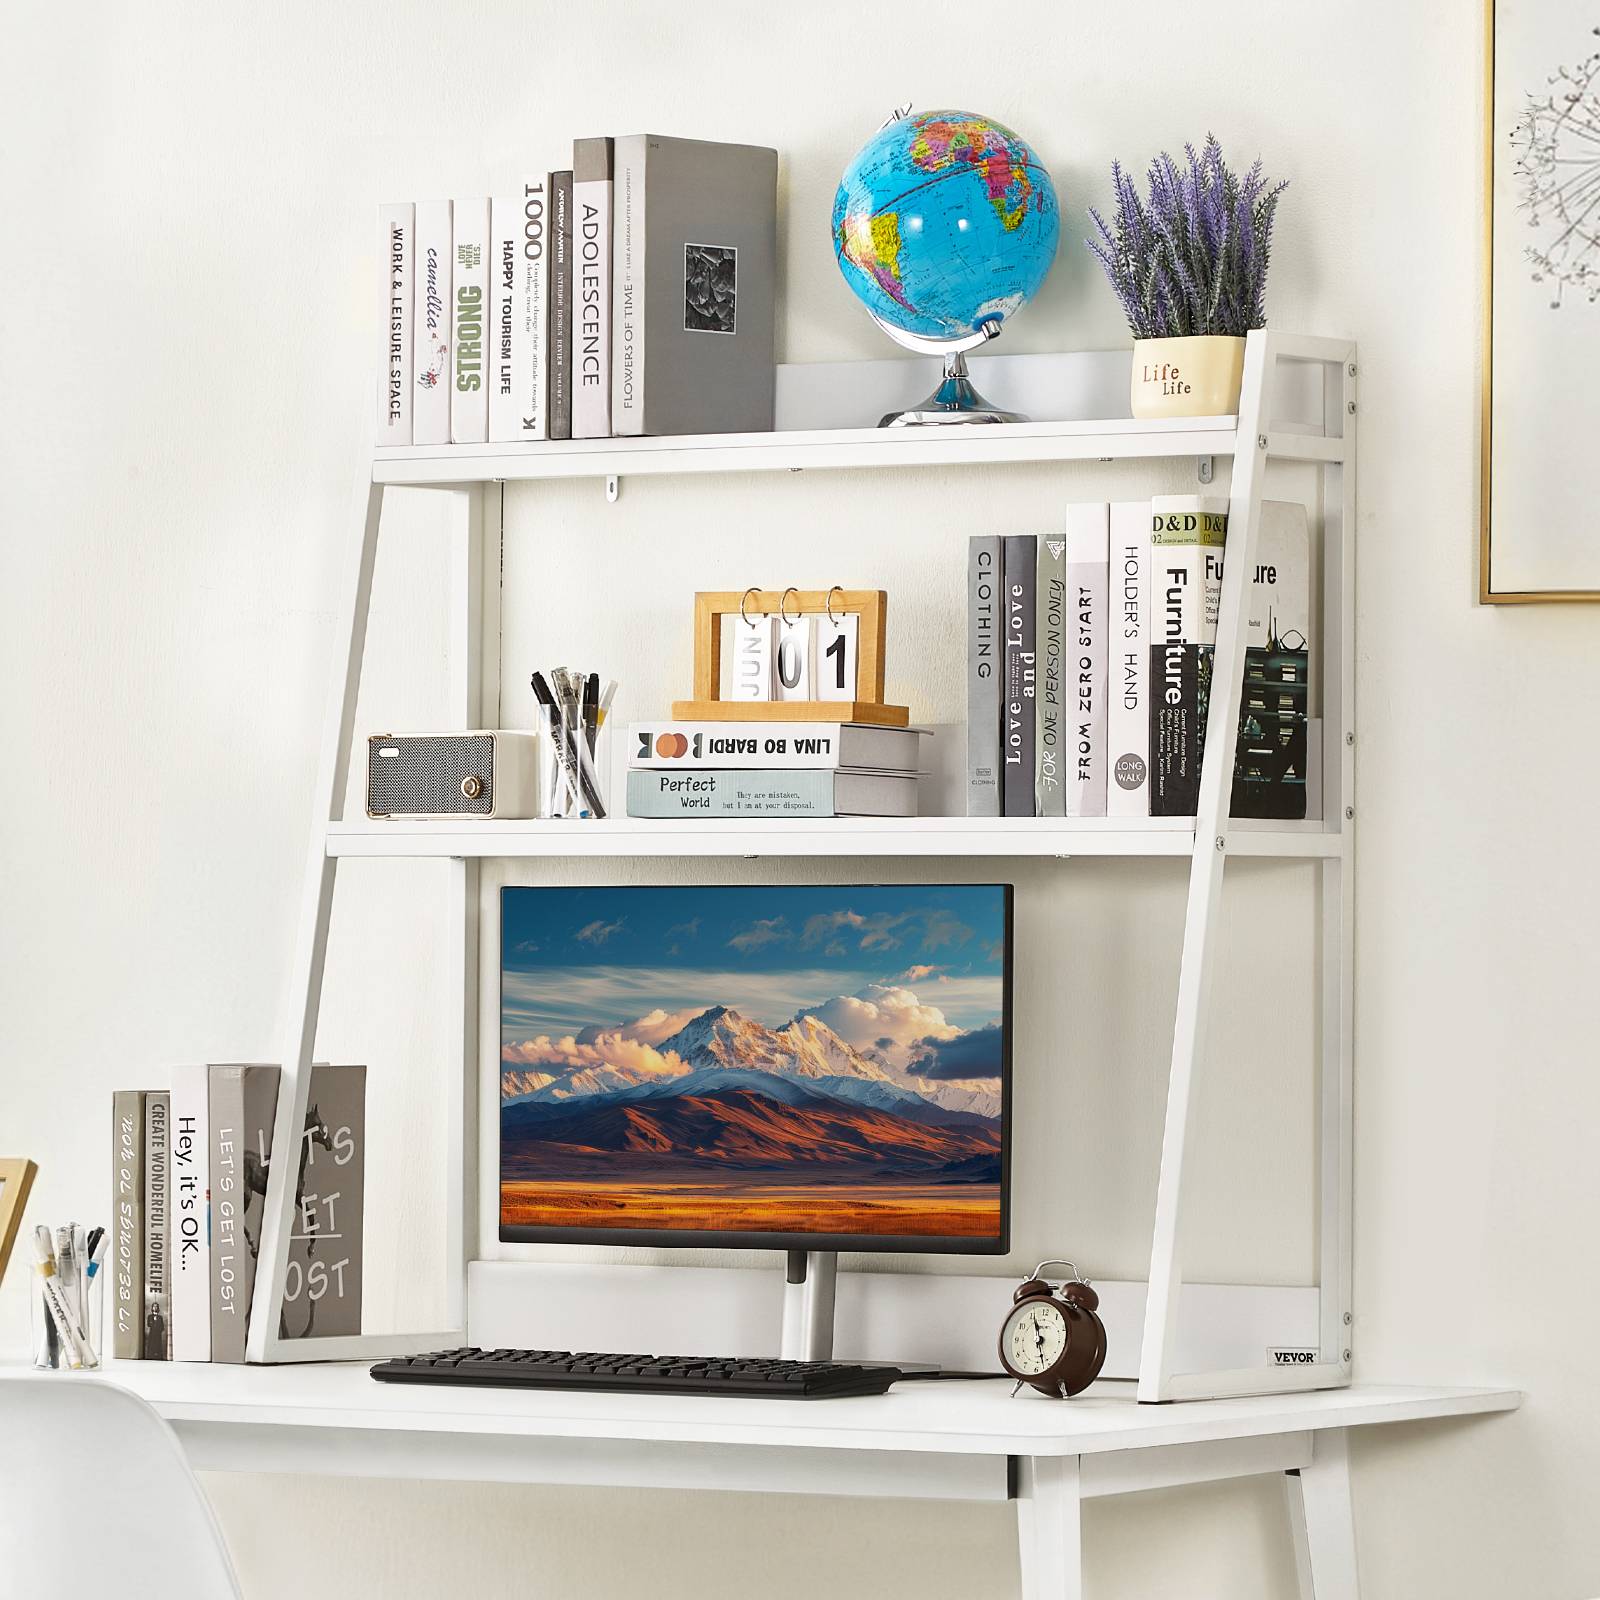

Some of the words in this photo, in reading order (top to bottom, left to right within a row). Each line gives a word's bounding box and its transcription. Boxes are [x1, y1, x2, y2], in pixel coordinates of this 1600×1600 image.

[524, 182, 544, 260] 1000
[392, 228, 404, 274] WORK
[458, 244, 466, 264] LOVE
[502, 240, 514, 290] HAPPY
[392, 280, 402, 290] &
[426, 248, 443, 331] camellia
[582, 204, 599, 387] ADOLESCENCE
[624, 284, 633, 319] TIME
[391, 296, 402, 362] LEISURE
[456, 286, 482, 392] STRONG
[501, 296, 514, 359] TOURISM
[624, 322, 633, 342] OF
[389, 370, 402, 420] SPACE
[500, 365, 511, 395] LIFE
[624, 345, 634, 409] FLOWERS
[1144, 364, 1180, 382] Life
[1163, 382, 1192, 396] Life
[977, 551, 992, 678] CLOTHING
[1008, 584, 1022, 647] Love
[1124, 546, 1139, 639] HOLDER'S
[1080, 587, 1092, 648] START
[1165, 568, 1188, 705] Furniture
[740, 636, 762, 696] JUN
[777, 636, 802, 689] 0
[826, 634, 846, 689] 1
[1020, 651, 1035, 698] and
[1046, 630, 1062, 705] PERSON
[1079, 656, 1092, 713] ZERO
[1124, 654, 1138, 711] HAND
[708, 738, 757, 754] BARDI
[764, 738, 786, 754] BO
[794, 738, 831, 754] LINA
[1006, 702, 1022, 764] Love
[1043, 710, 1058, 746] ONE
[1078, 724, 1092, 781] FROM
[1118, 761, 1143, 772] LONG
[660, 777, 716, 792] Perfect
[736, 792, 752, 800] They
[1118, 772, 1144, 782] WALK.
[680, 796, 710, 808] World
[783, 801, 815, 810] disposal.
[151, 1103, 165, 1148] CREATE
[175, 1117, 196, 1166] Hey,
[258, 1126, 354, 1168] LT'S
[120, 1168, 132, 1194] TO
[220, 1128, 234, 1192] LET'S
[150, 1152, 164, 1228] WONDERFUL
[180, 1176, 198, 1210] it's
[300, 1192, 340, 1234] ET
[182, 1218, 199, 1271] OK...
[220, 1202, 234, 1247] GET
[118, 1201, 134, 1301] BELONGS
[150, 1233, 163, 1294] HOMELIFE
[220, 1257, 236, 1315] LOST
[284, 1258, 350, 1302] OST
[118, 1307, 132, 1332] IT
[1274, 1352, 1314, 1362] VEVOR
